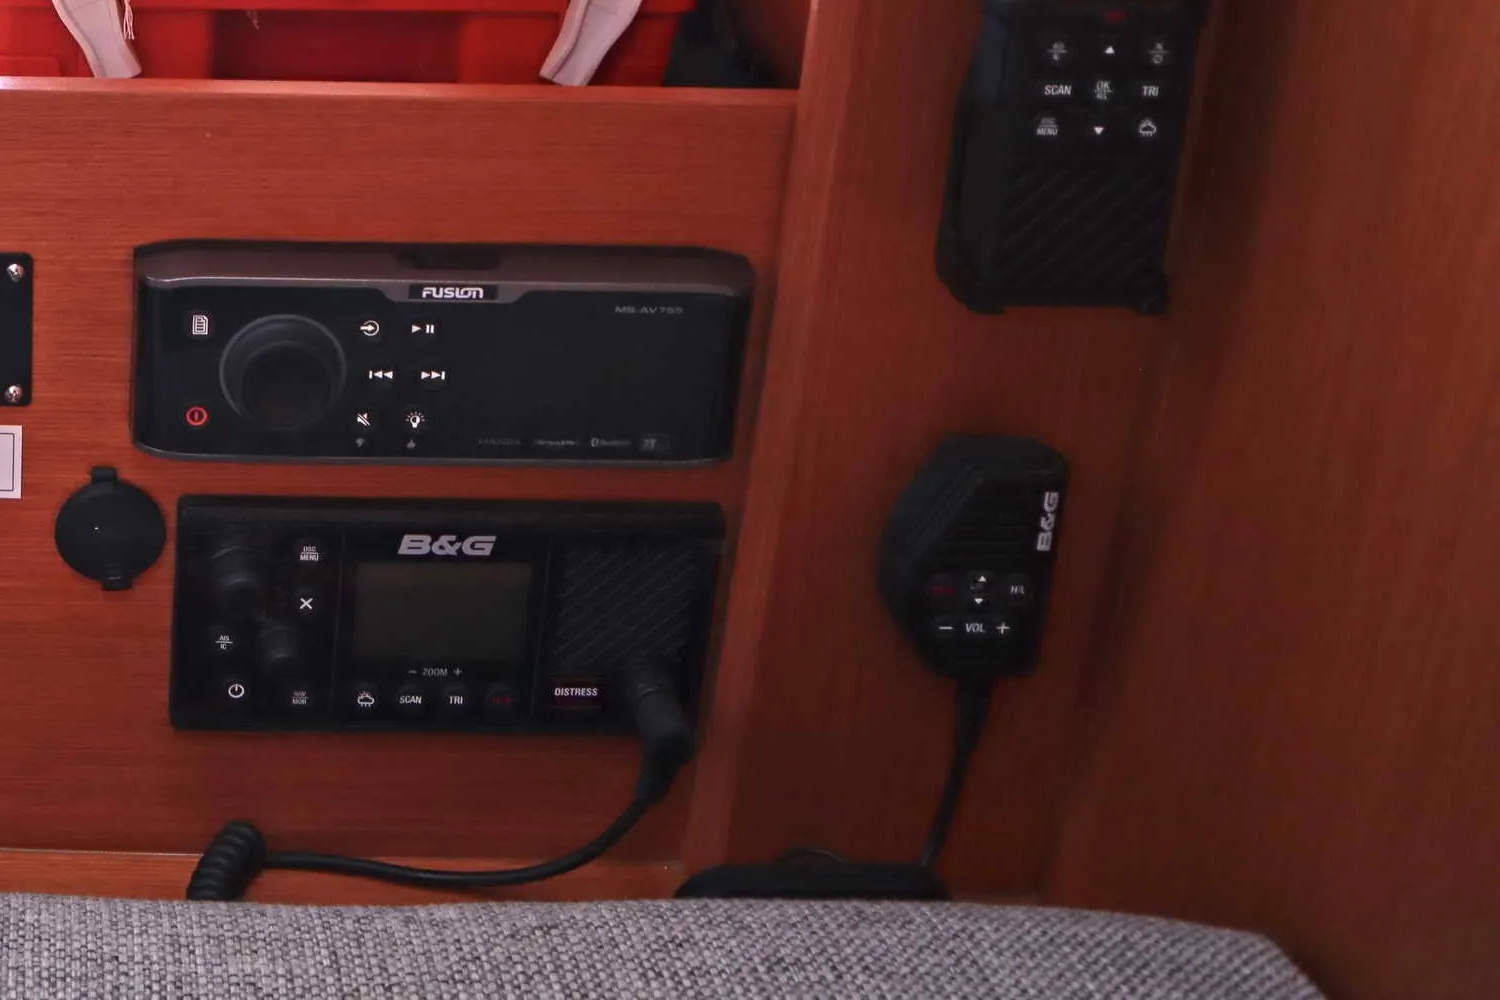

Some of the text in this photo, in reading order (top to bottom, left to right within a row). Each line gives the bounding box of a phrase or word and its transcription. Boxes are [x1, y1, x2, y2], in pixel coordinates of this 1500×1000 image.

[1044, 84, 1072, 96] SCAN
[1142, 85, 1159, 97] TRI
[421, 286, 484, 299] FUSION
[1035, 491, 1060, 552] B&G
[397, 534, 497, 556] B&G
[299, 553, 319, 562] MENU
[965, 623, 986, 633] VOL
[421, 667, 448, 677] ZOOM
[553, 687, 599, 697] DISTRESS
[399, 695, 422, 705] SCAN
[449, 695, 464, 705] TRI
